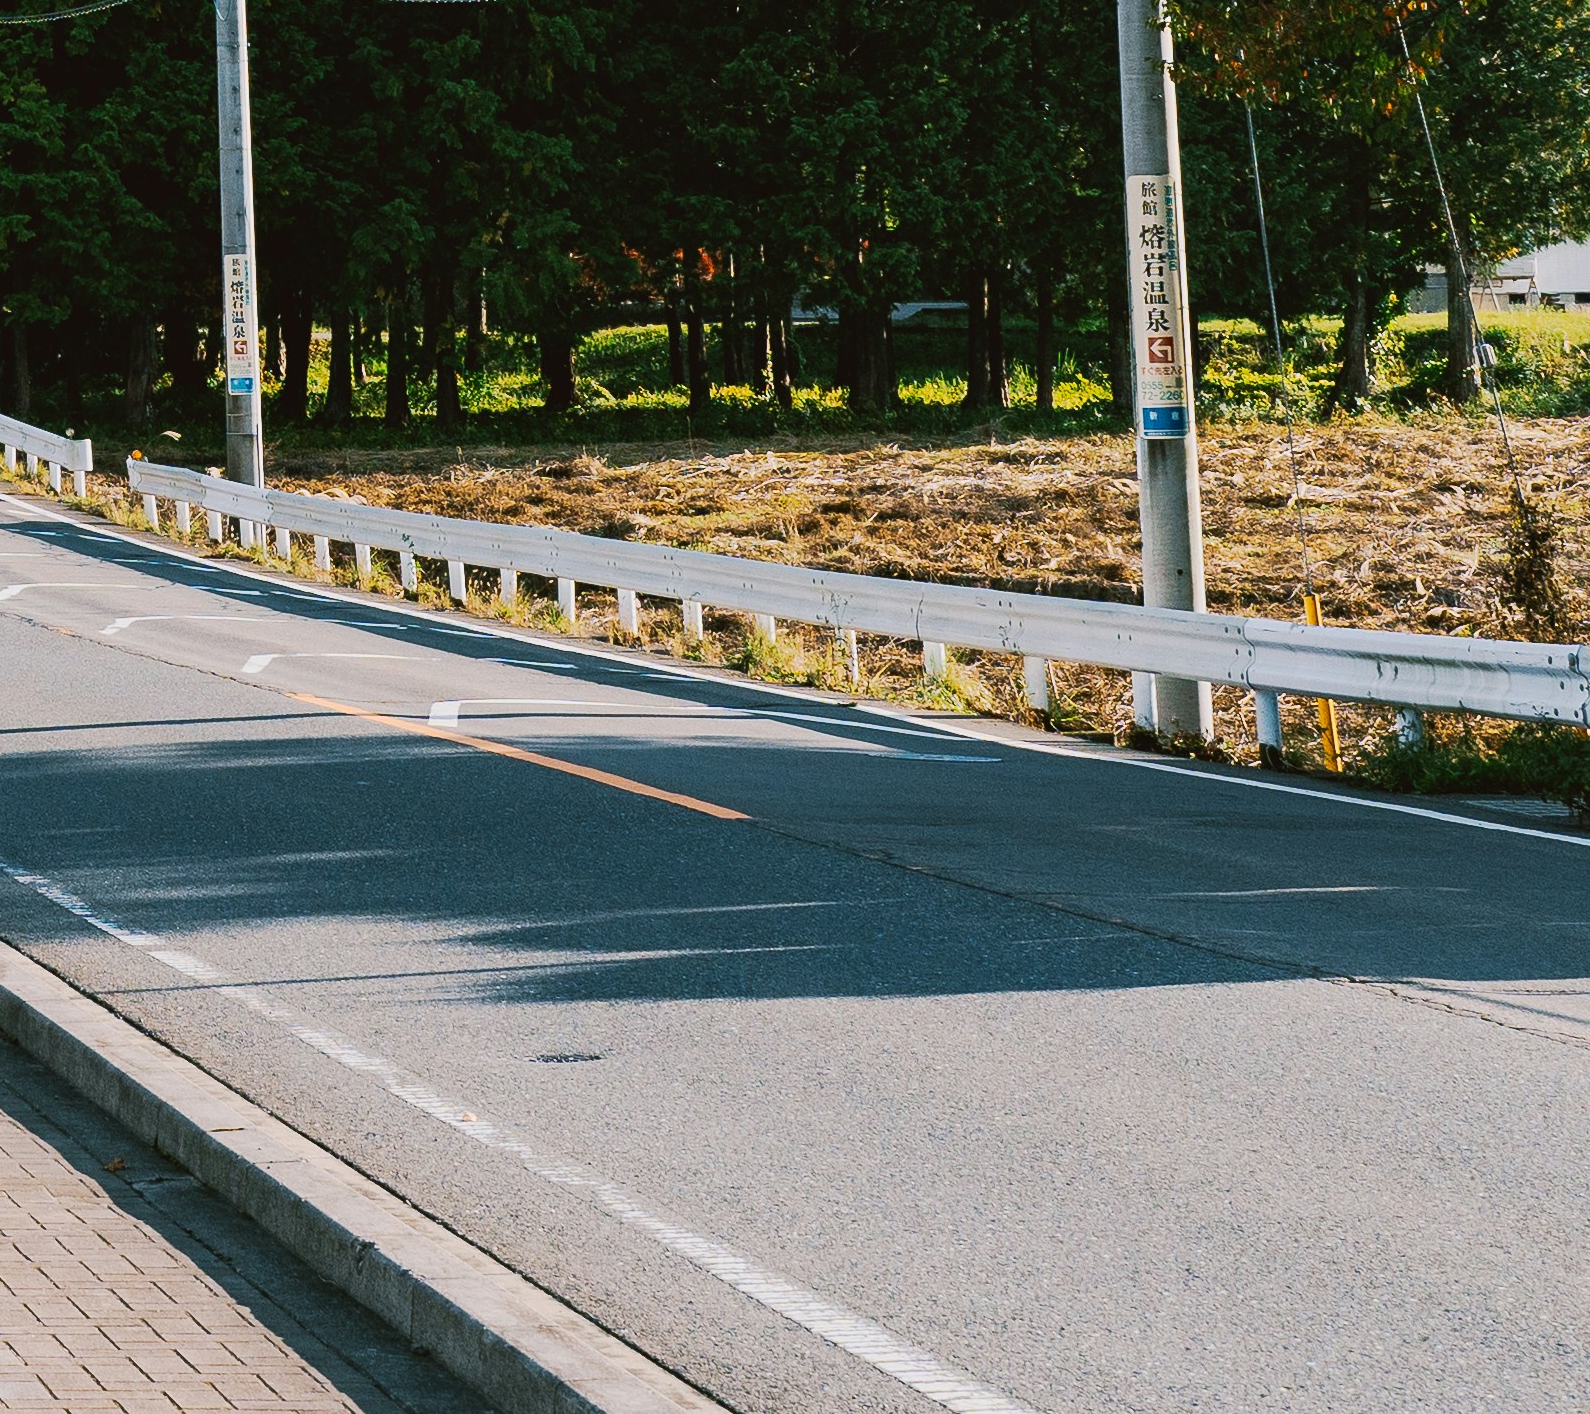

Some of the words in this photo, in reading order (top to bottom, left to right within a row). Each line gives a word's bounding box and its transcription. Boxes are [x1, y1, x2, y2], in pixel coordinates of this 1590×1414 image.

[1141, 182, 1158, 216] 旅館
[1139, 224, 1171, 332] 熔岩温泉
